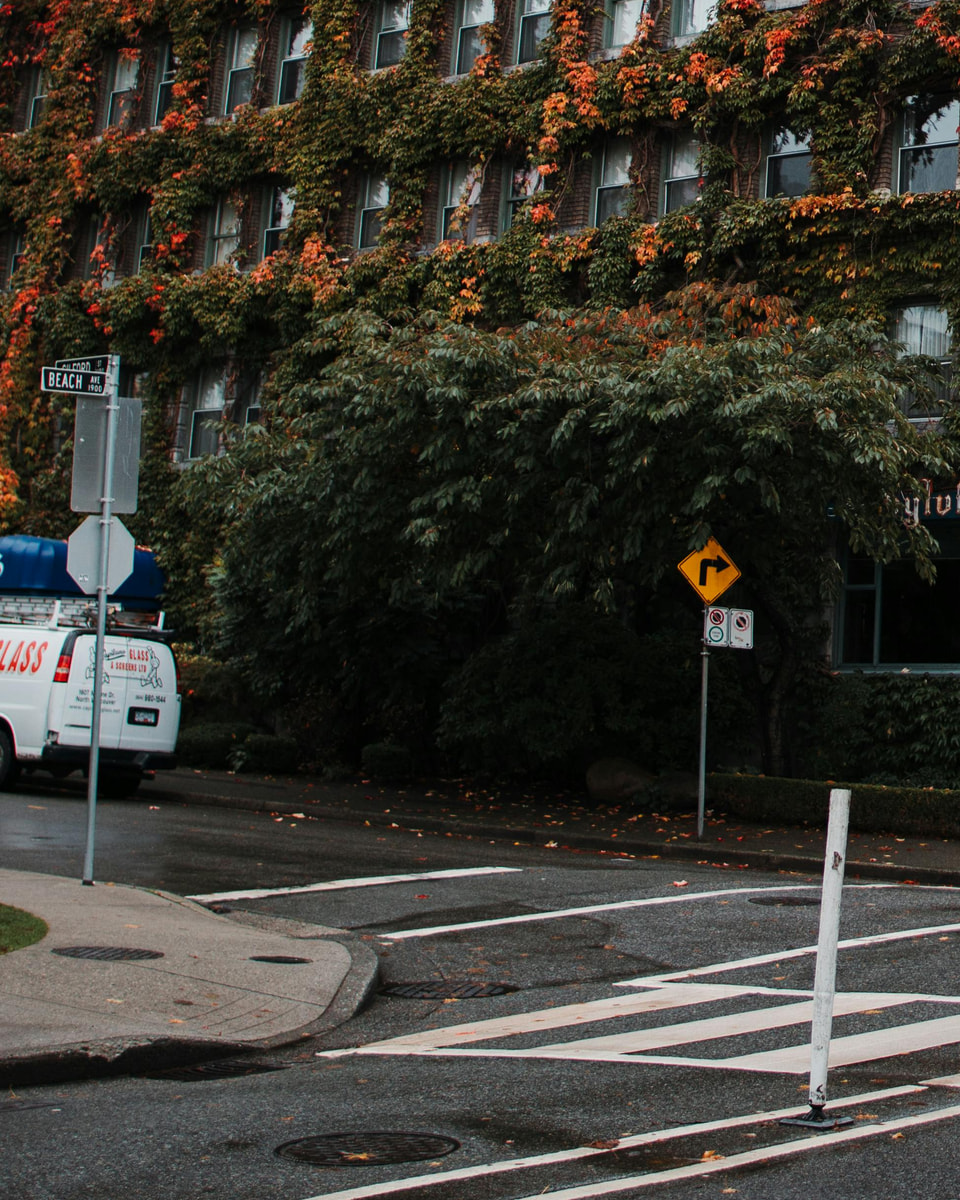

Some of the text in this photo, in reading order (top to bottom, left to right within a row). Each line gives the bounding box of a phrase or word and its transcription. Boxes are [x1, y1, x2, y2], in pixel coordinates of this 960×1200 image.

[48, 371, 100, 389] BEACH AVE
[88, 384, 102, 392] 1900
[0, 640, 49, 674] LASS
[129, 648, 149, 662] GLASS
[115, 662, 137, 672] SCREENS
